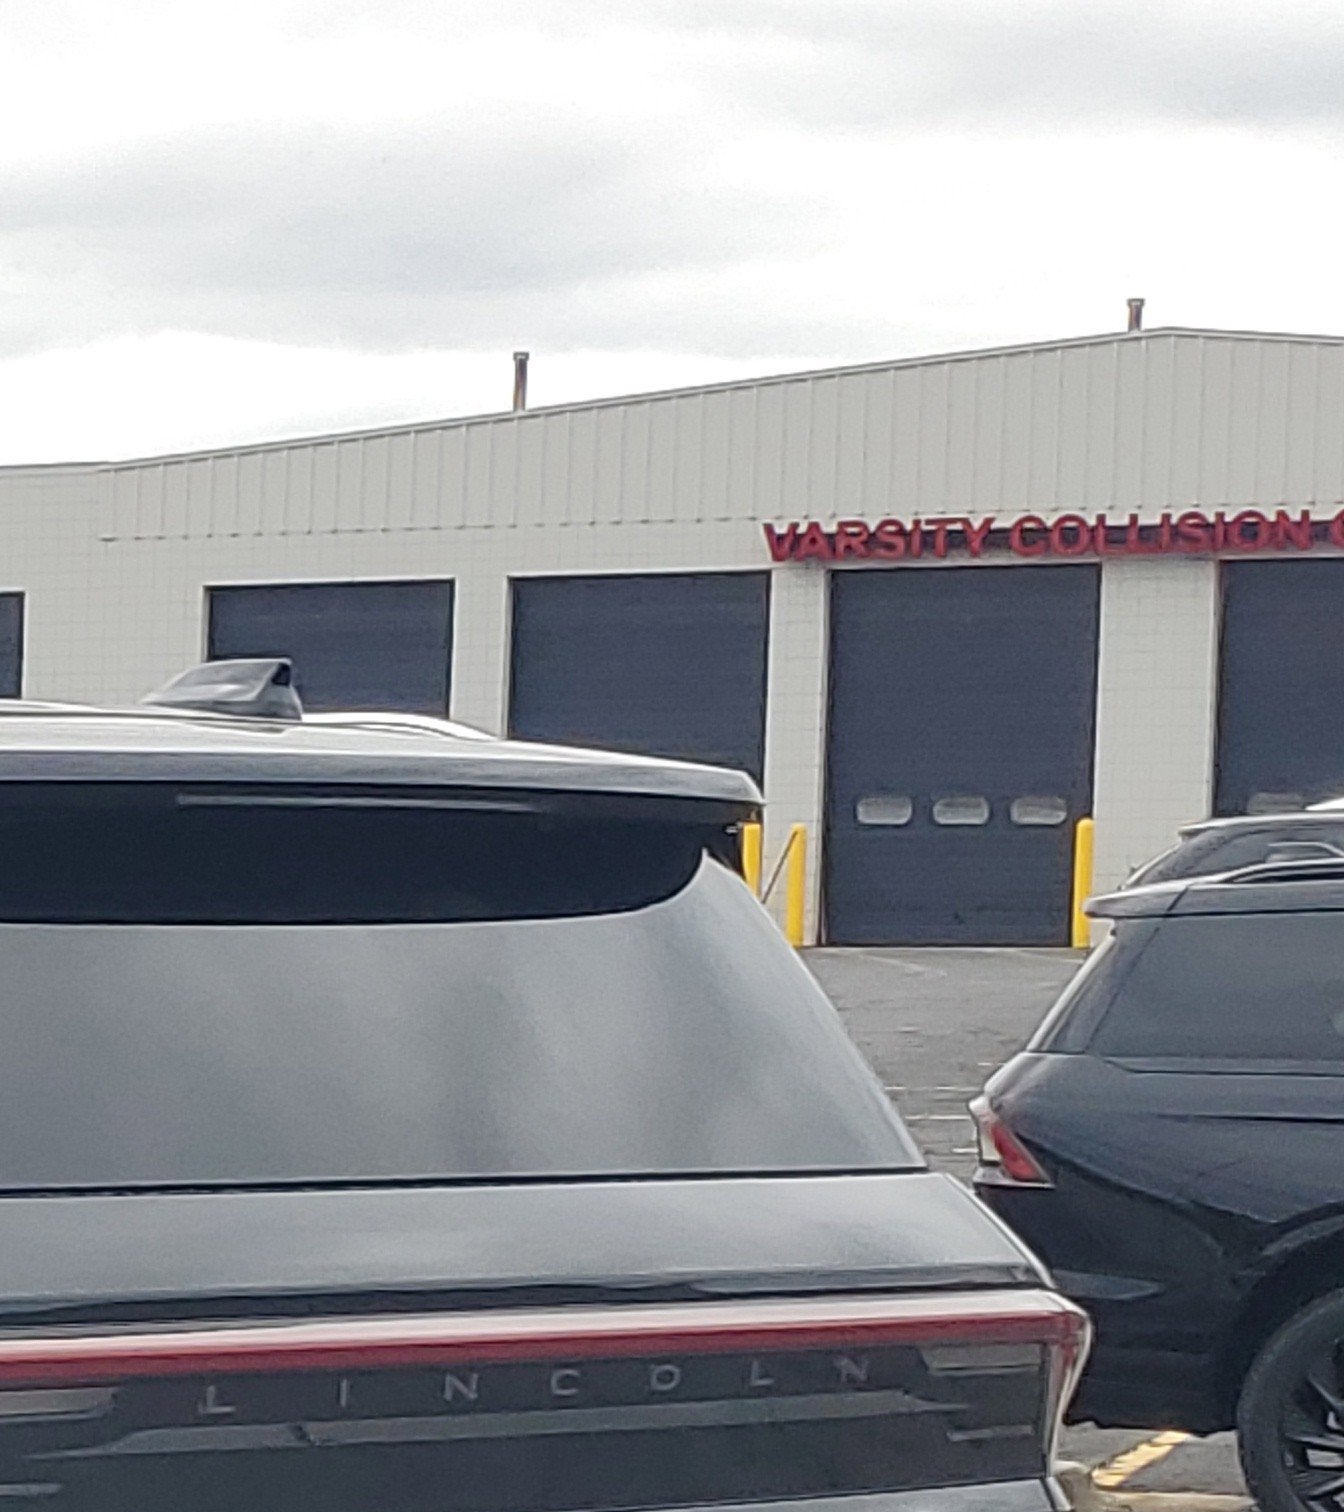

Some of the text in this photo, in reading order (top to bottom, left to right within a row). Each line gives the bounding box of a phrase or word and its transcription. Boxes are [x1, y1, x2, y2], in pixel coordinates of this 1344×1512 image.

[763, 516, 996, 562] VARSITY
[1009, 508, 1310, 560] COLLISION
[197, 1355, 869, 1415] LINCOLN
